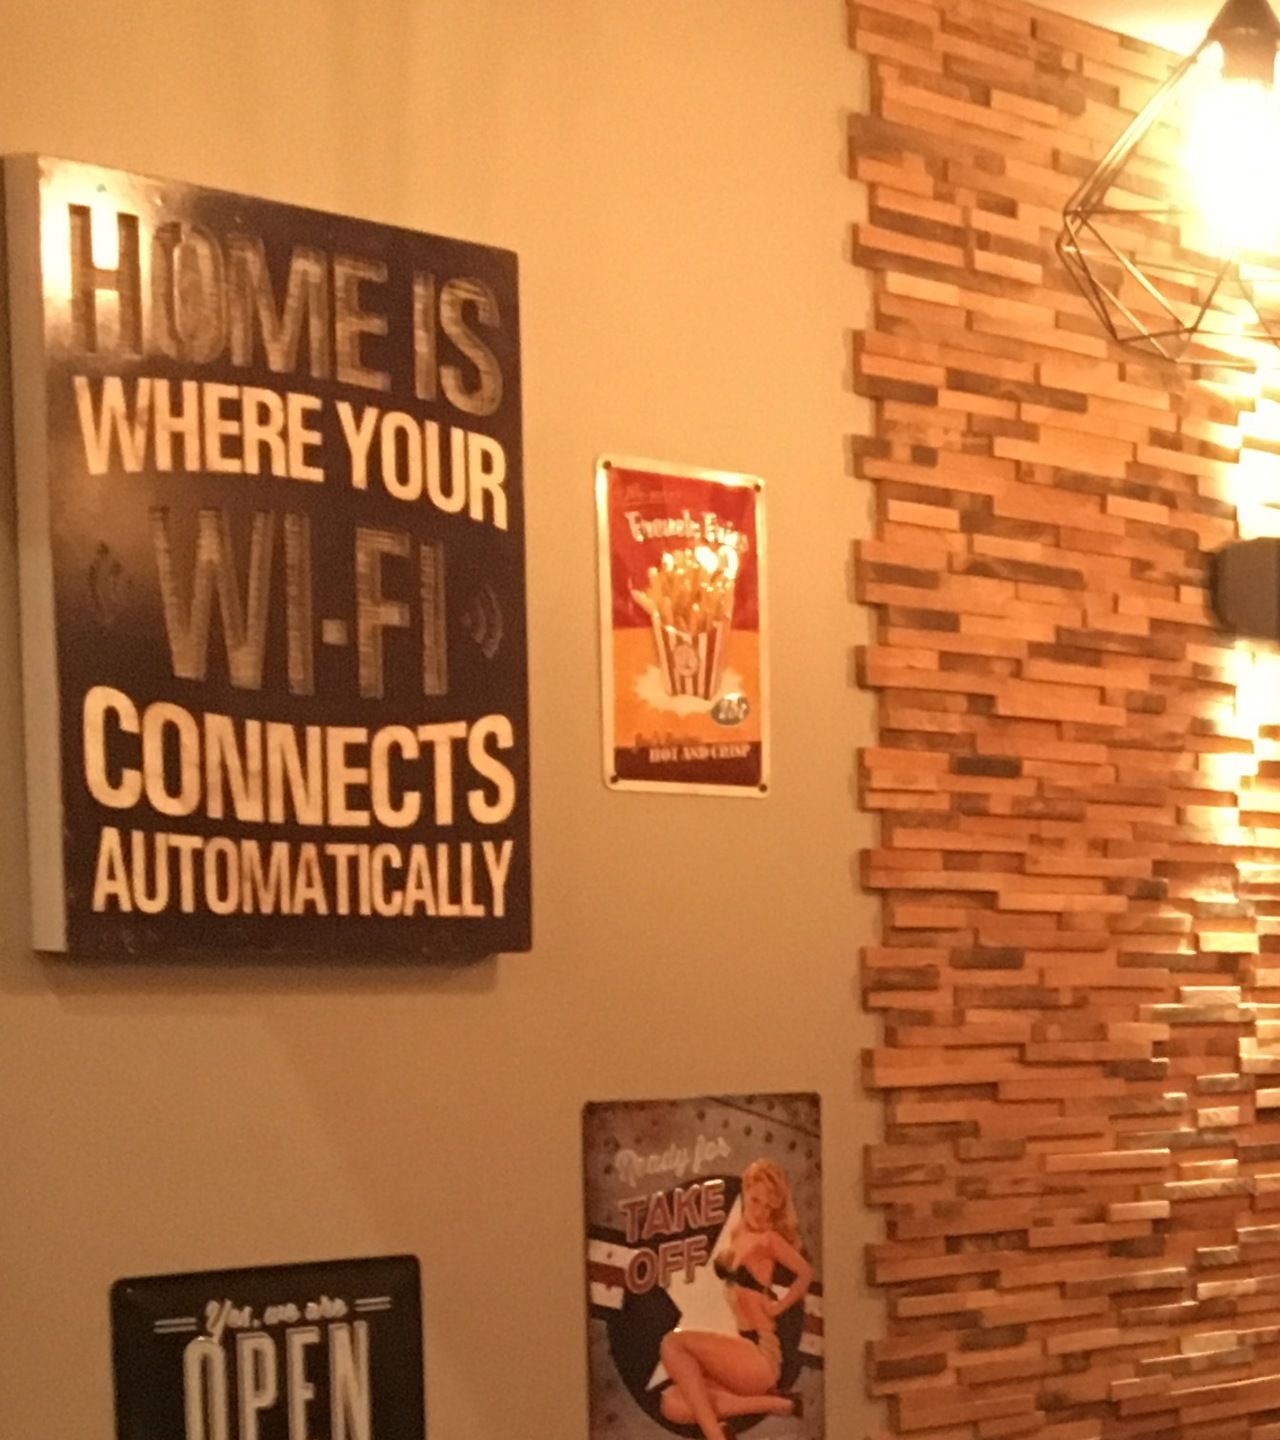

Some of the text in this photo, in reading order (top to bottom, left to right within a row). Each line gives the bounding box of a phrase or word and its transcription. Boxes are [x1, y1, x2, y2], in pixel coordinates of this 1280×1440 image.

[68, 203, 504, 417] HOME IS
[74, 375, 507, 530] WHERE YOUR
[149, 505, 448, 699] WI-FI
[82, 686, 516, 828] CONNECTS
[91, 825, 514, 919] AUTOMATICALLY
[618, 1178, 726, 1243] TAKE
[624, 1235, 710, 1294] OFF
